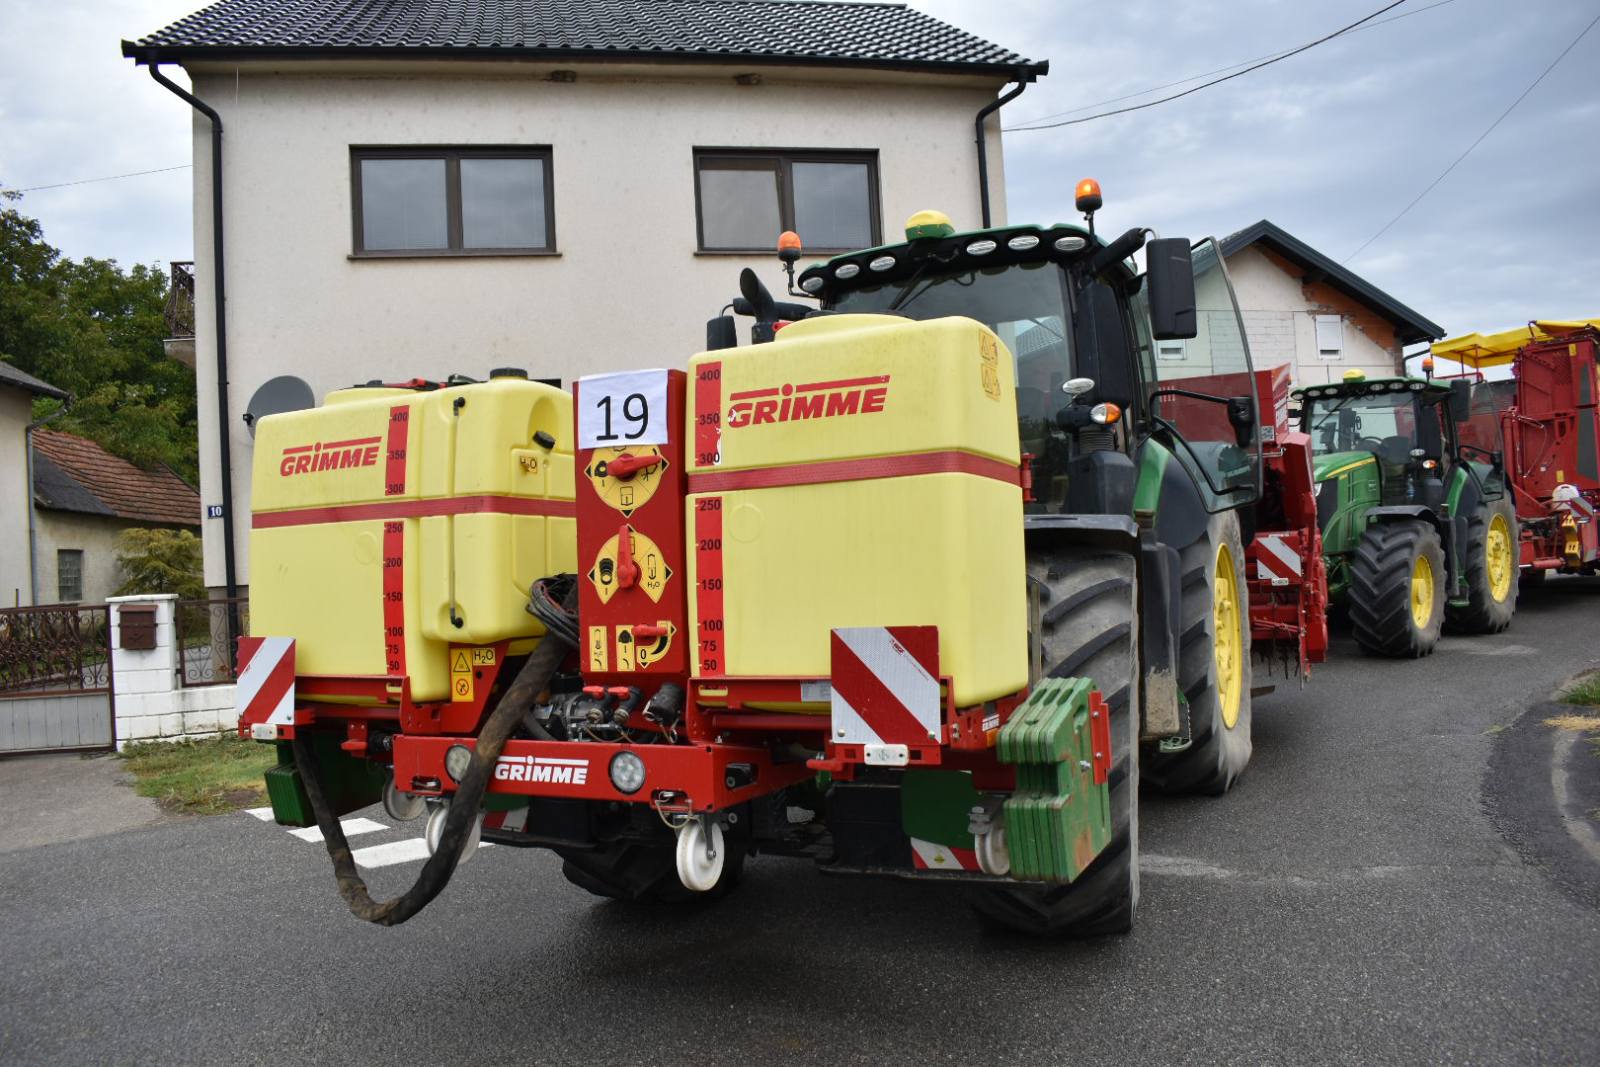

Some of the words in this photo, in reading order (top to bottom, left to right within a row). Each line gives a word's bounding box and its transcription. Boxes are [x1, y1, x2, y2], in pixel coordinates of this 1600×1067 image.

[700, 369, 720, 381] 400
[728, 384, 888, 428] GRIMME
[392, 412, 408, 421] 400
[596, 393, 649, 441] 19
[700, 413, 720, 425] 350
[280, 442, 380, 477] GRIMME
[389, 450, 406, 460] 350
[700, 452, 720, 464] 300
[387, 484, 404, 494] 300
[700, 499, 721, 511] 250
[211, 506, 222, 517] 10
[387, 524, 402, 533] 250
[700, 539, 721, 550] 200
[386, 557, 402, 567] 200
[702, 579, 722, 590] 150
[386, 592, 402, 601] 150
[703, 620, 722, 631] 100
[388, 627, 403, 636] 100
[388, 645, 399, 654] 75
[703, 640, 717, 651] 75
[389, 661, 400, 670] 50
[704, 660, 717, 671] 50
[495, 756, 589, 785] GRIMME
